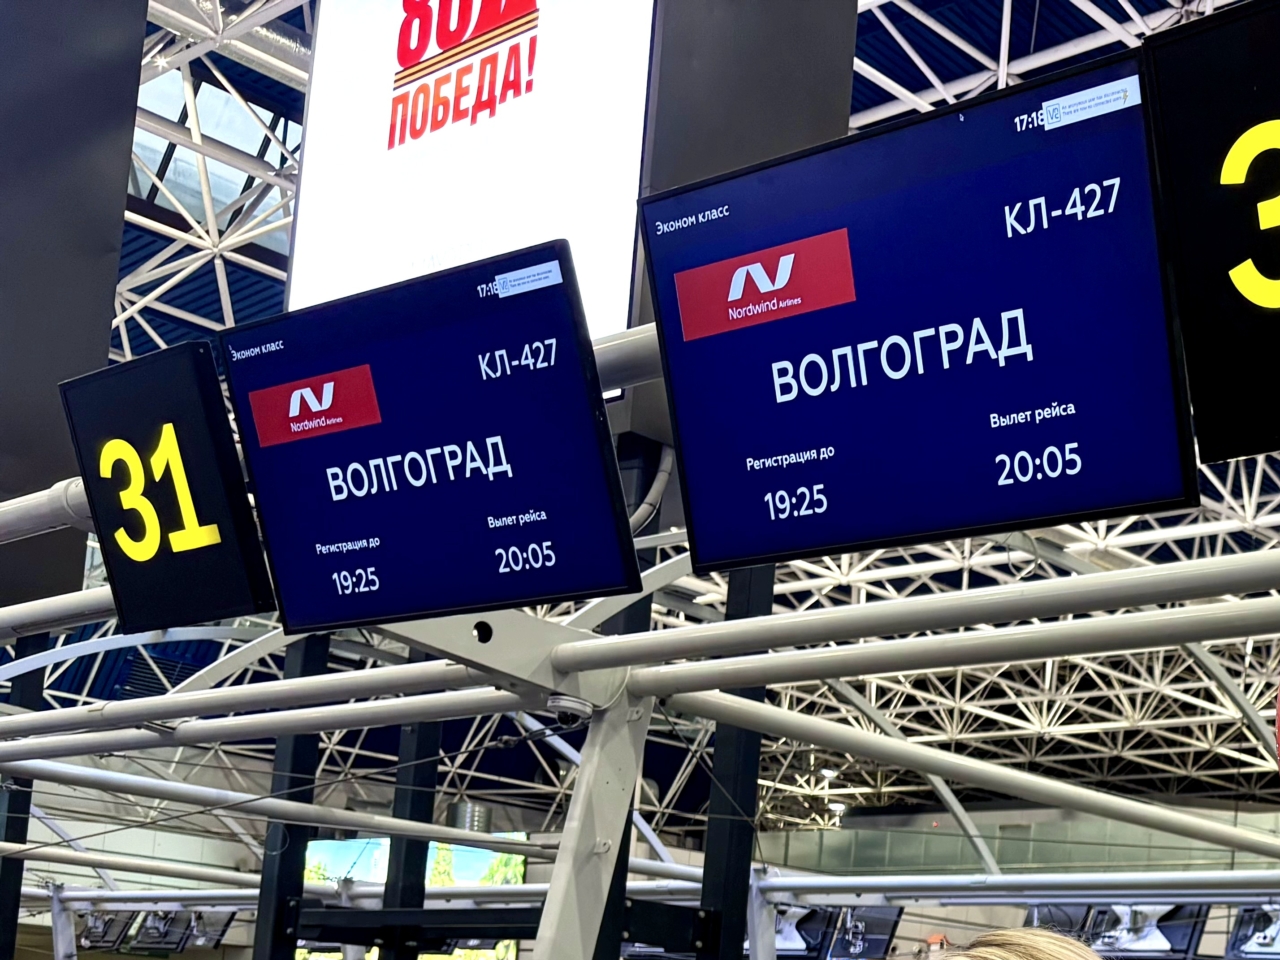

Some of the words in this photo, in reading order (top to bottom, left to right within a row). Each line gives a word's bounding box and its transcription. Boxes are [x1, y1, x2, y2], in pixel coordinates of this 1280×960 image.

[387, 34, 538, 151] ПОБЕДА!
[655, 213, 696, 235] Эконом
[698, 205, 730, 223] класс
[1004, 177, 1121, 238] КЛ-427
[728, 297, 778, 320] Nordwind
[779, 297, 802, 309] Airlines
[231, 345, 261, 361] Эконом
[261, 340, 285, 354] класс
[478, 338, 557, 380] КЛ-427
[771, 308, 1034, 404] ВОЛГОГРАД
[290, 416, 326, 433] Nordwind
[989, 409, 1032, 429] Вылет
[1035, 402, 1076, 422] рейса
[326, 435, 513, 501] ВОЛГОГРАД
[746, 449, 818, 472] Регистрация
[819, 446, 835, 462] до
[995, 442, 1083, 486] 20:05
[100, 422, 222, 562] 31
[764, 483, 829, 521] 19:25
[487, 515, 517, 529] Вылет
[518, 509, 547, 527] рейса
[315, 538, 368, 555] Регистрация
[369, 537, 380, 549] до
[495, 541, 556, 573] 20:05
[332, 567, 380, 595] 19:25
